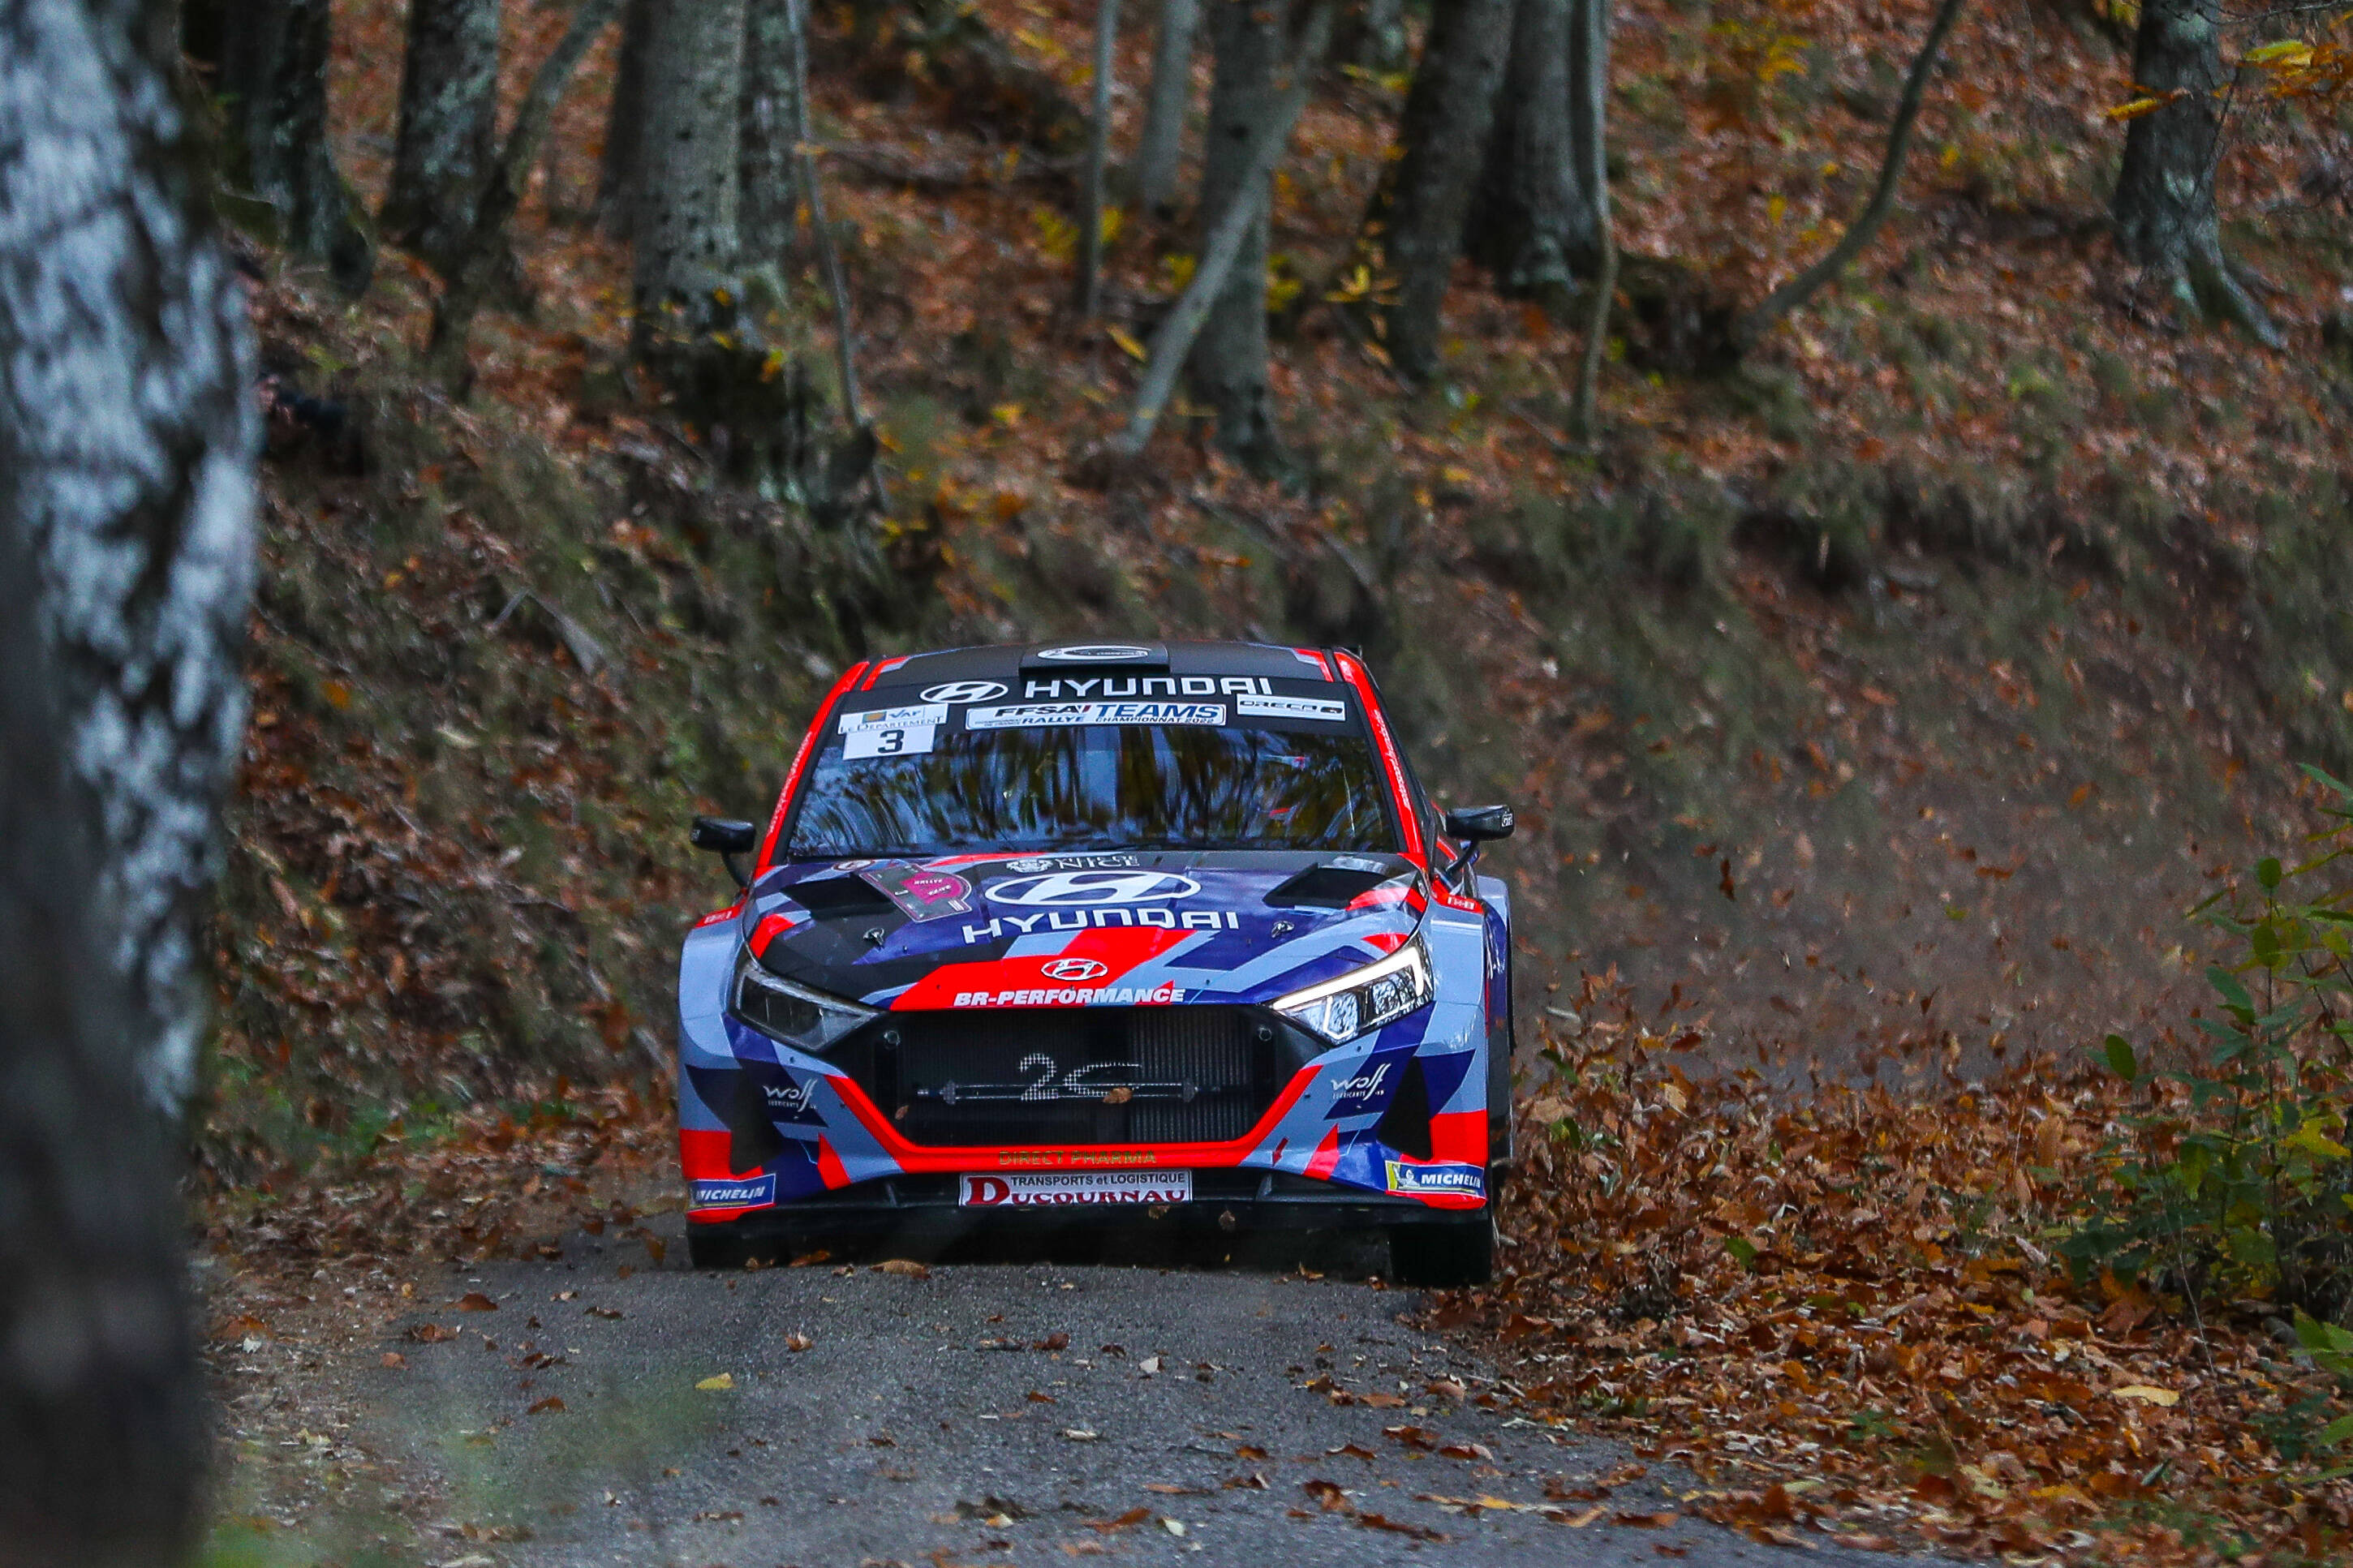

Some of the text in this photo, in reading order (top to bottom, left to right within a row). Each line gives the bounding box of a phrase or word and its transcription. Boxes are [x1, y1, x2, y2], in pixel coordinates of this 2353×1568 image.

[1025, 677, 1271, 698] HYUNDAI
[995, 704, 1220, 719] FFSA TEAMS
[1022, 716, 1085, 724] RALLYE
[877, 728, 905, 754] 3
[1055, 855, 1139, 870] NICE
[961, 908, 1240, 944] HYUNDAI
[953, 987, 1187, 1007] BR-PERFORMANCE
[999, 1149, 1157, 1165] DIRECT PHARMA
[1011, 1175, 1095, 1186] TRANSPORTS
[1110, 1173, 1185, 1185] LOGISTIQUE
[1421, 1174, 1481, 1188] MICHELIN
[966, 1176, 1186, 1205] DUCOURNAU
